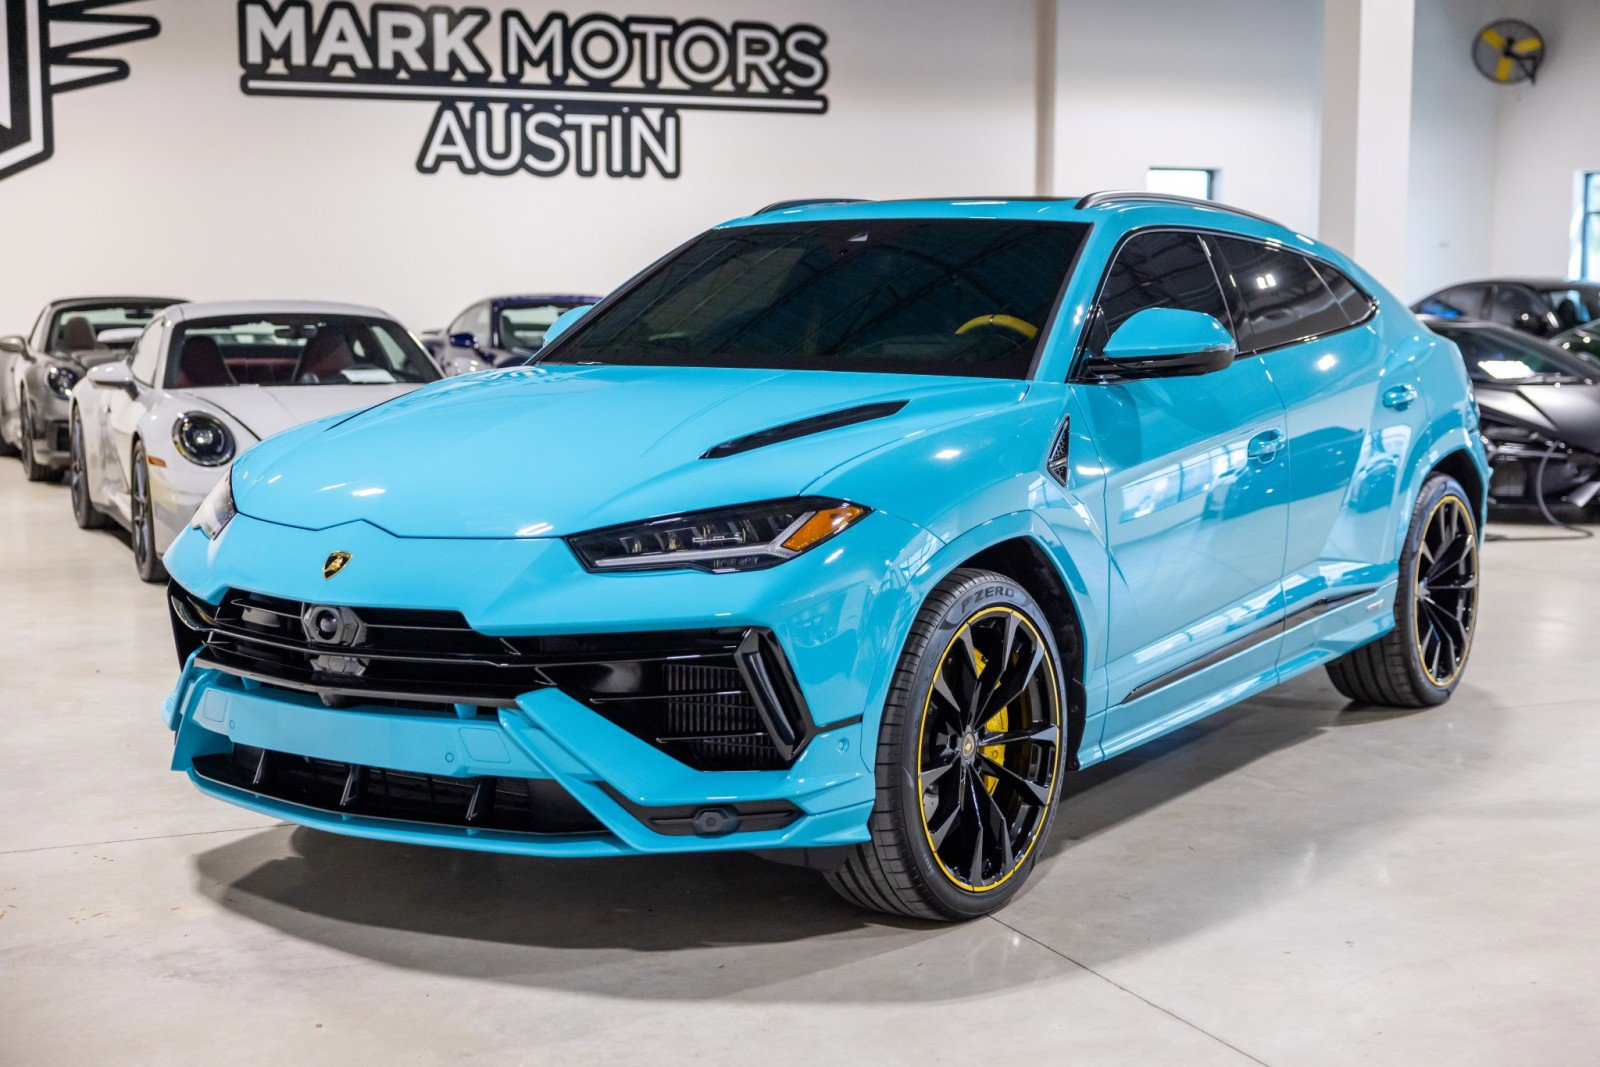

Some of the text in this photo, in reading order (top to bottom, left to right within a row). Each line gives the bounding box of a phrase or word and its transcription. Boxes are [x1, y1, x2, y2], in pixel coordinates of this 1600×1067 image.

[243, 2, 826, 89] MARK MOTORS
[419, 107, 679, 176] AUSTIN
[961, 586, 1015, 613] P ZERO
